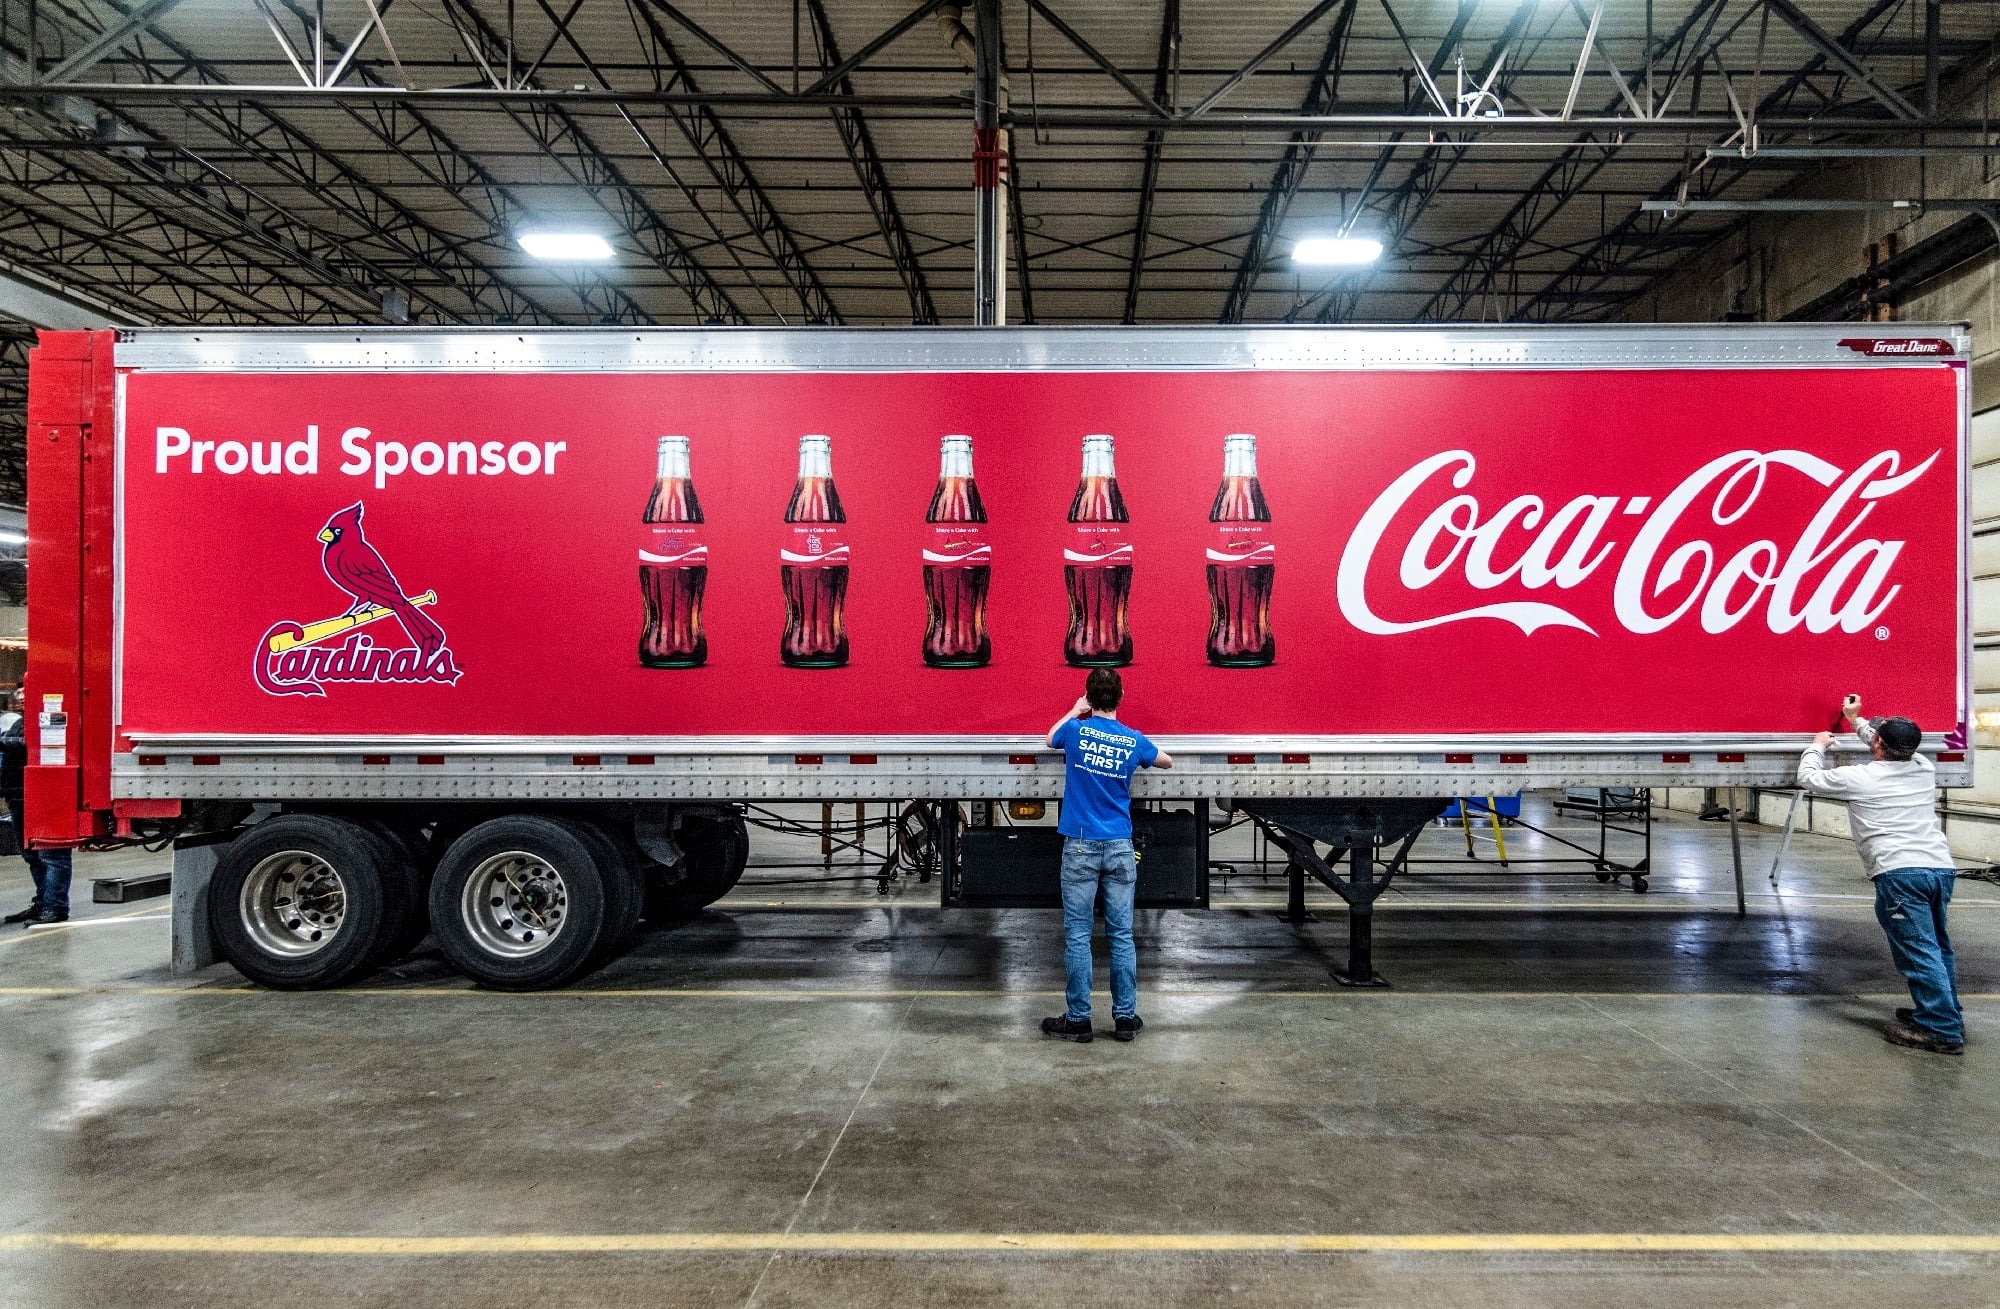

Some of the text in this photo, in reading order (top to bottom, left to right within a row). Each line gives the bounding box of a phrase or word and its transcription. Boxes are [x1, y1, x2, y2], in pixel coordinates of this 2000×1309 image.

[1873, 340, 1938, 353] Great Dane
[155, 424, 567, 489] Proud Sponsor
[1336, 448, 1941, 637] Coca-Cola
[253, 620, 464, 697] Cardinals
[1078, 739, 1134, 760] SAFETY
[1083, 752, 1124, 771] FIRST
